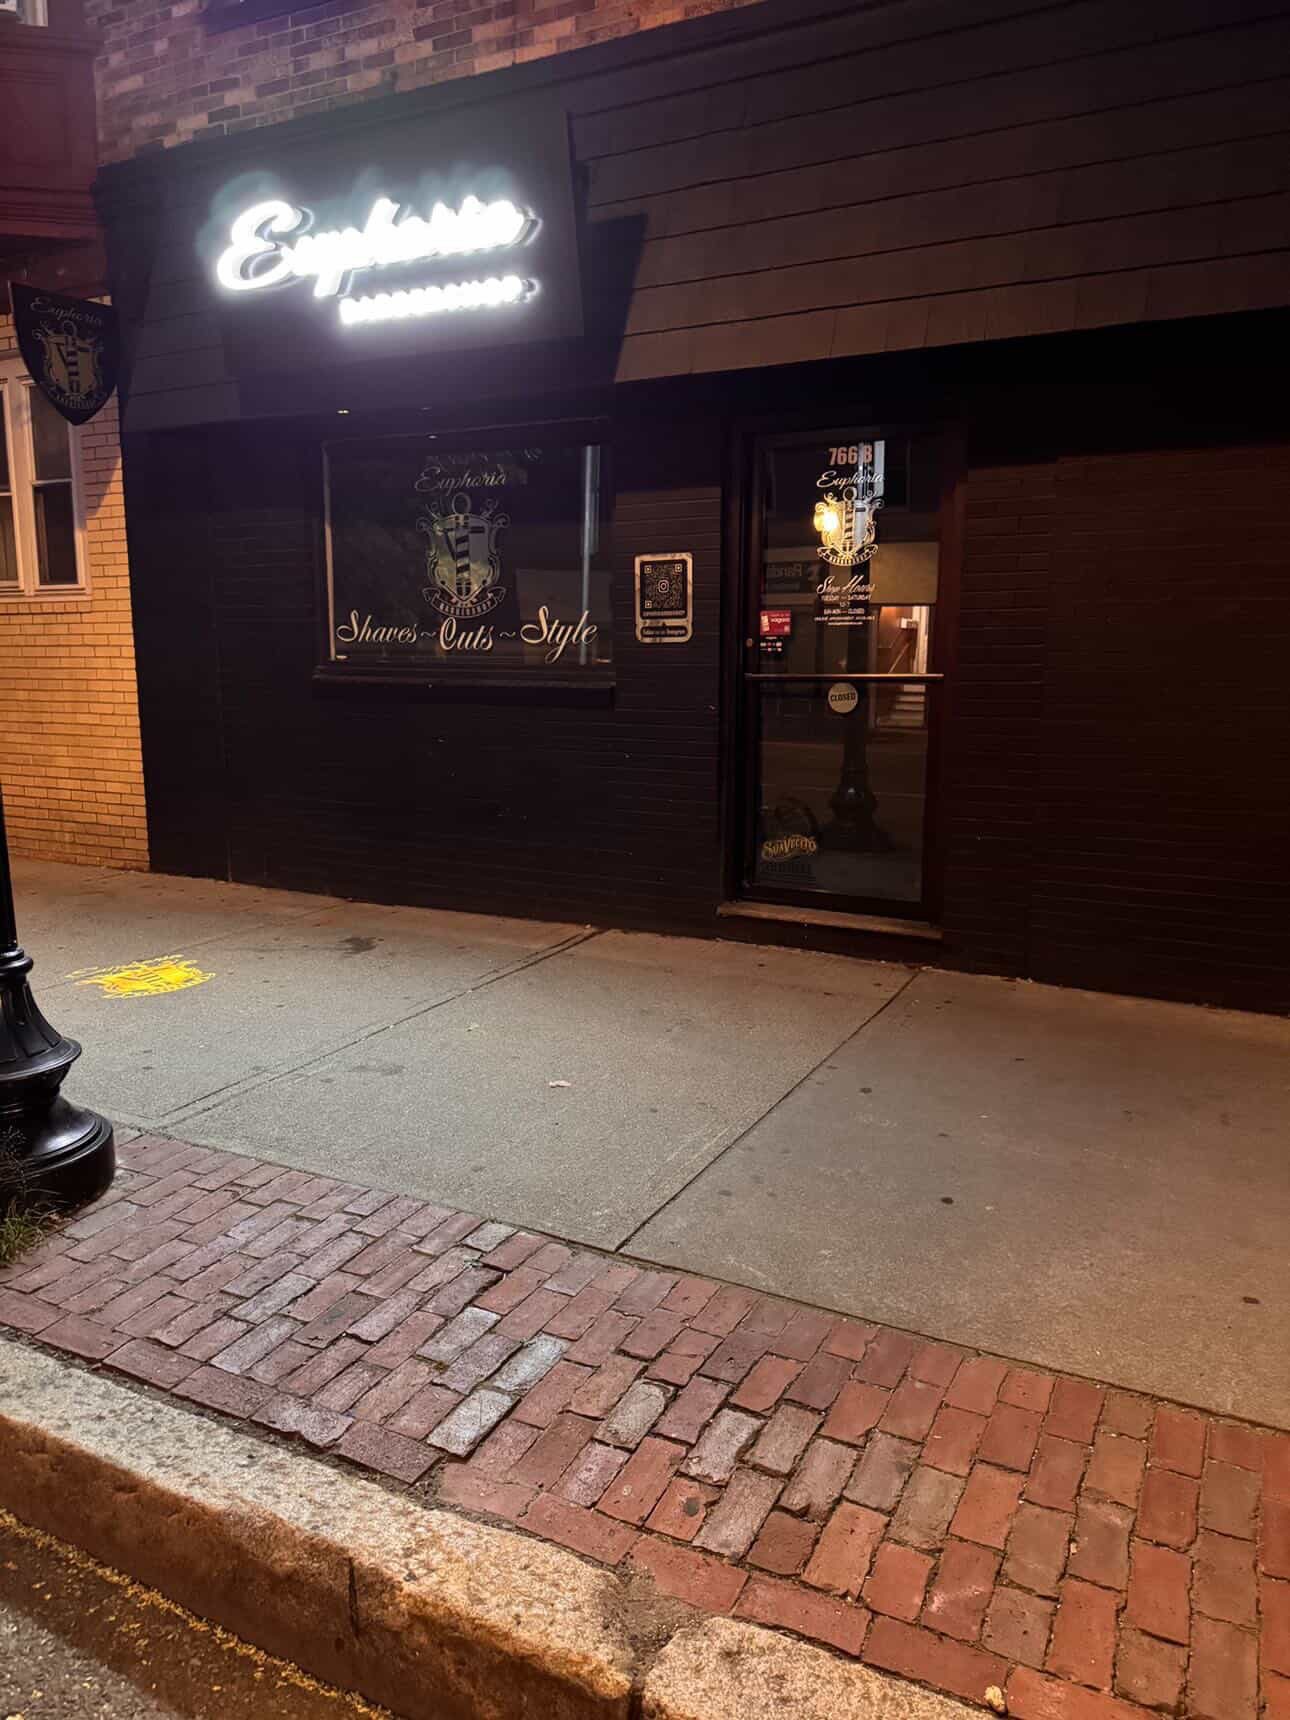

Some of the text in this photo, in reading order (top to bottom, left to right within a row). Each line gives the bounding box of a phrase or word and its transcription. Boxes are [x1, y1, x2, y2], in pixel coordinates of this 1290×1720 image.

[828, 445, 858, 466] 766
[414, 466, 506, 496] Euphoria
[816, 470, 883, 490] Euphoria
[336, 609, 417, 644] Shaves
[439, 617, 494, 651] Cuts
[520, 606, 598, 664] Style
[830, 692, 856, 702] CLOSED
